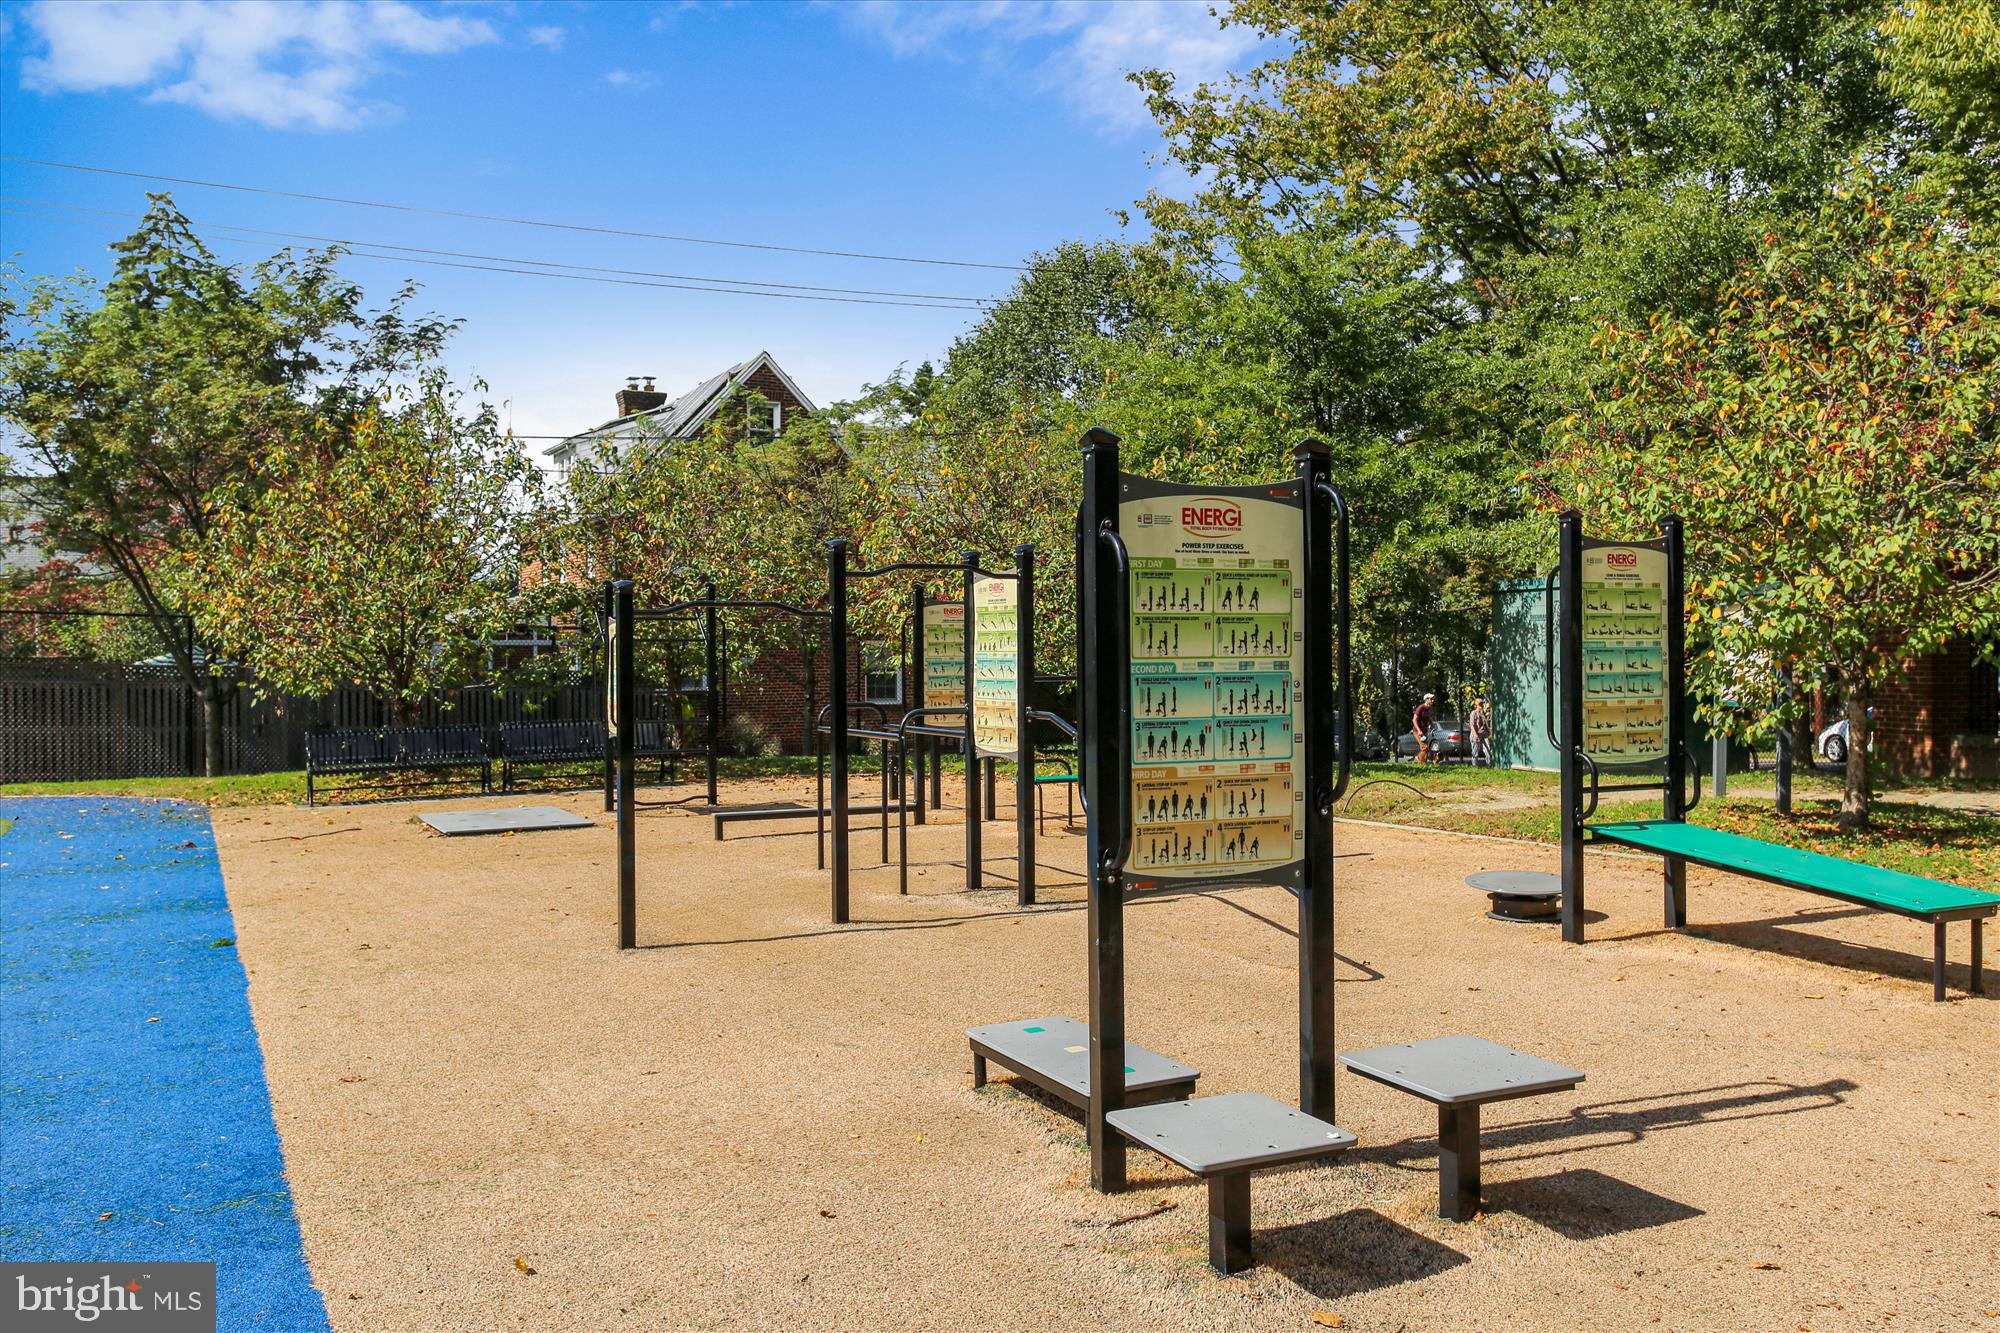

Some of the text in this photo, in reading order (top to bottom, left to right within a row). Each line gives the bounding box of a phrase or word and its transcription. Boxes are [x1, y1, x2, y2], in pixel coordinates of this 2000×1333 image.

[1182, 507, 1242, 527] ENERGI
[1607, 553, 1637, 565] ENERGI
[1148, 560, 1164, 568] DAY
[1135, 572, 1139, 580] 1
[1216, 573, 1221, 581] 2
[1135, 617, 1140, 626] 3
[1216, 616, 1221, 625] 4
[1131, 665, 1157, 673] ECOND
[1158, 664, 1174, 673] DAY
[1135, 678, 1139, 686] 1
[1216, 676, 1221, 685] 2
[1135, 722, 1140, 731] 3
[1216, 720, 1222, 729] 4
[1151, 769, 1167, 778] DAY
[1136, 783, 1140, 791] 1
[1217, 780, 1222, 788] 2
[1217, 823, 1222, 831] 4
[1136, 828, 1141, 837] 3
